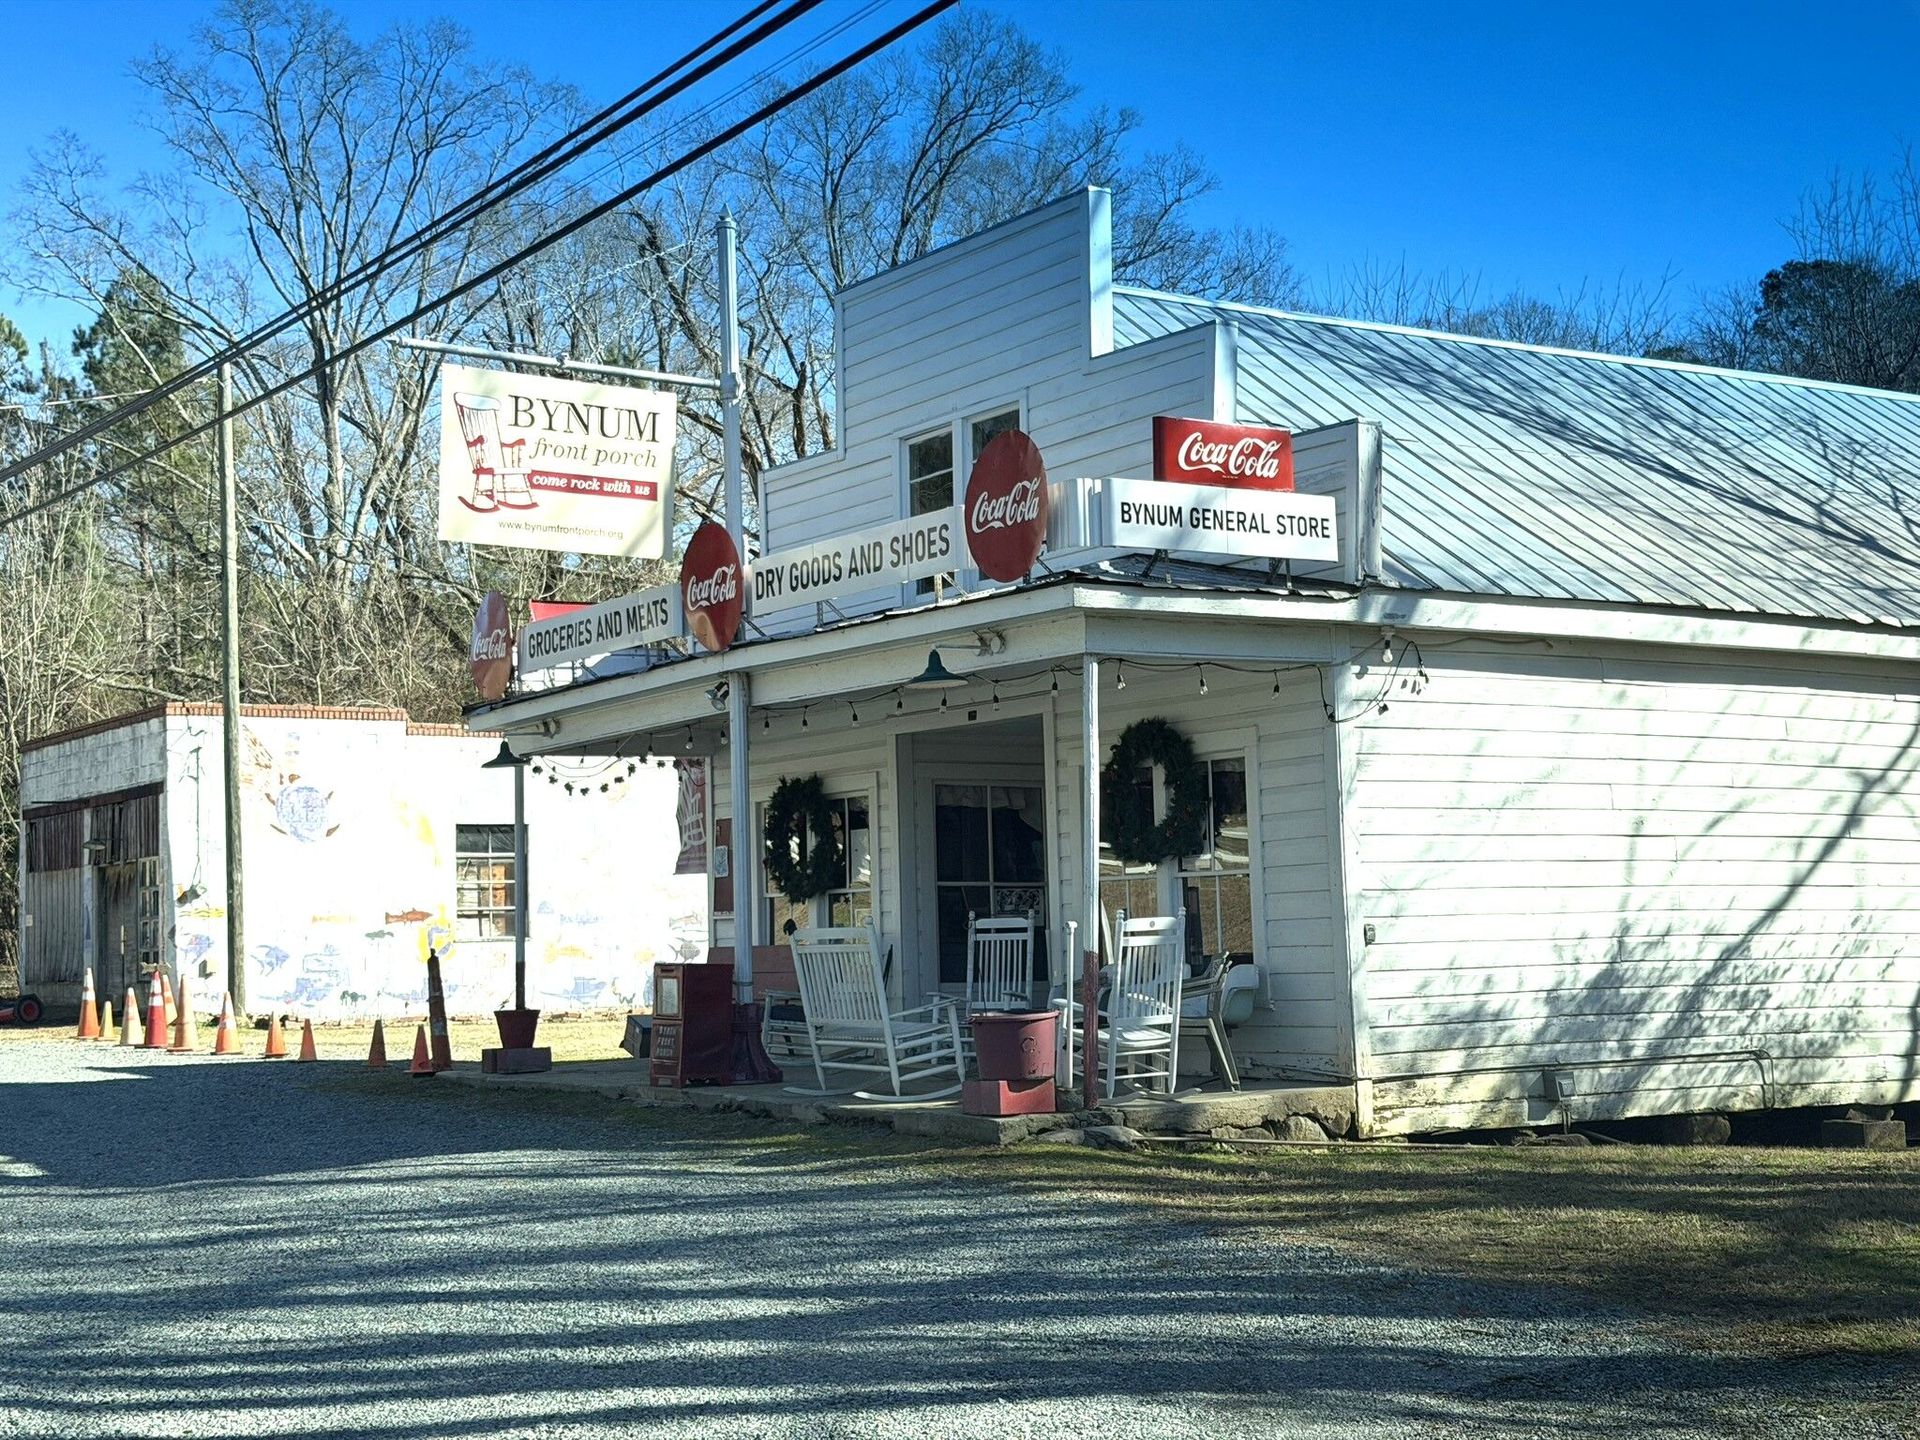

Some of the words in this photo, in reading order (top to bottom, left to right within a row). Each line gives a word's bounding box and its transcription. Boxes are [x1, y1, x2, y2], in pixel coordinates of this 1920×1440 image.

[508, 394, 660, 443] BYNUM
[529, 437, 588, 461] front
[593, 447, 657, 468] porch
[1177, 431, 1283, 479] Coca-Cola
[532, 474, 567, 488] come
[570, 477, 601, 492] rock
[603, 481, 631, 495] with
[634, 485, 651, 496] us
[971, 476, 1041, 534] Coca-Cola
[498, 520, 624, 540] www.bynumfrontporch.org
[1120, 501, 1183, 528] BYNUM
[1189, 506, 1271, 535] GENERAL
[1276, 514, 1331, 539] STORE
[755, 565, 785, 600] DRY
[789, 551, 843, 593] GOODS
[848, 541, 883, 579] AND
[890, 523, 950, 568] SHOES
[687, 563, 737, 611] Coca-Cola
[528, 618, 592, 659] GROCERIES
[596, 611, 622, 643] AND
[626, 597, 669, 635] MEATS
